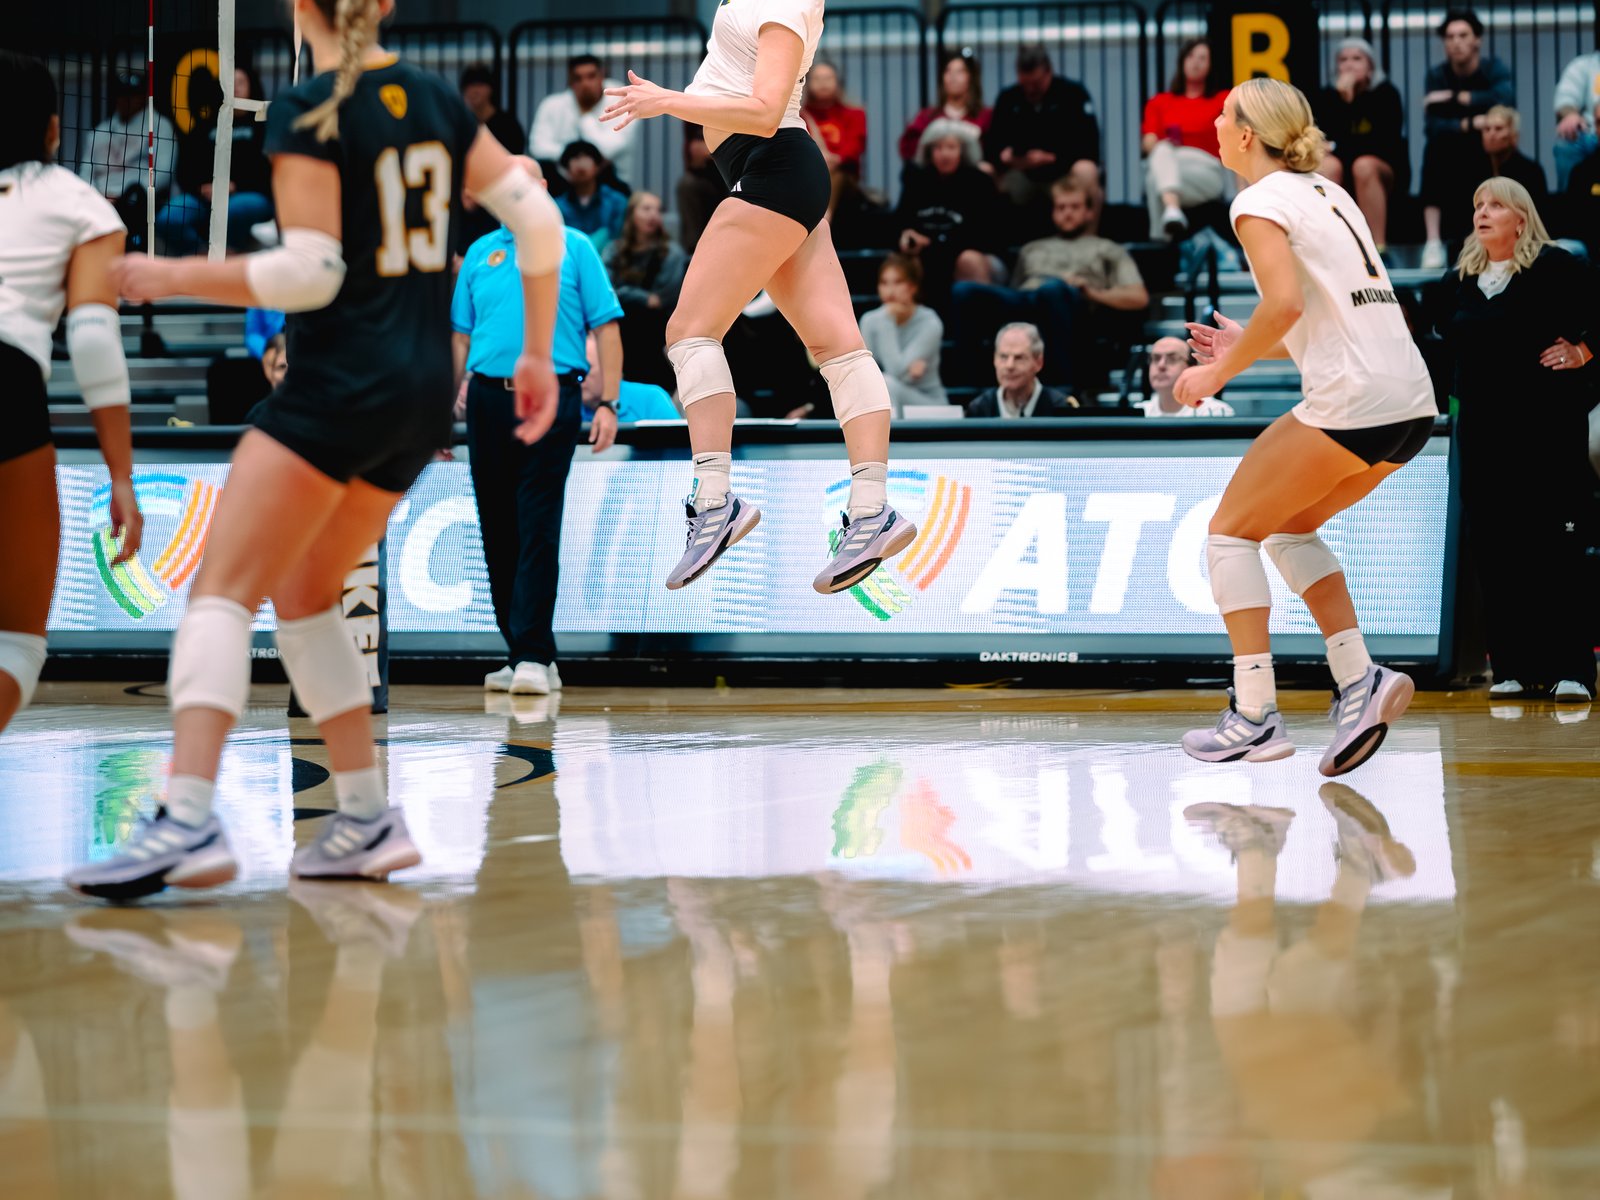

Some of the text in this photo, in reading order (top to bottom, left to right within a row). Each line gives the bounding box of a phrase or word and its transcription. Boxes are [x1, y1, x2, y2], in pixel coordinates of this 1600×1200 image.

[374, 140, 452, 277] 13
[1331, 205, 1381, 279] 1
[979, 650, 1080, 664] DAKTRONICS
